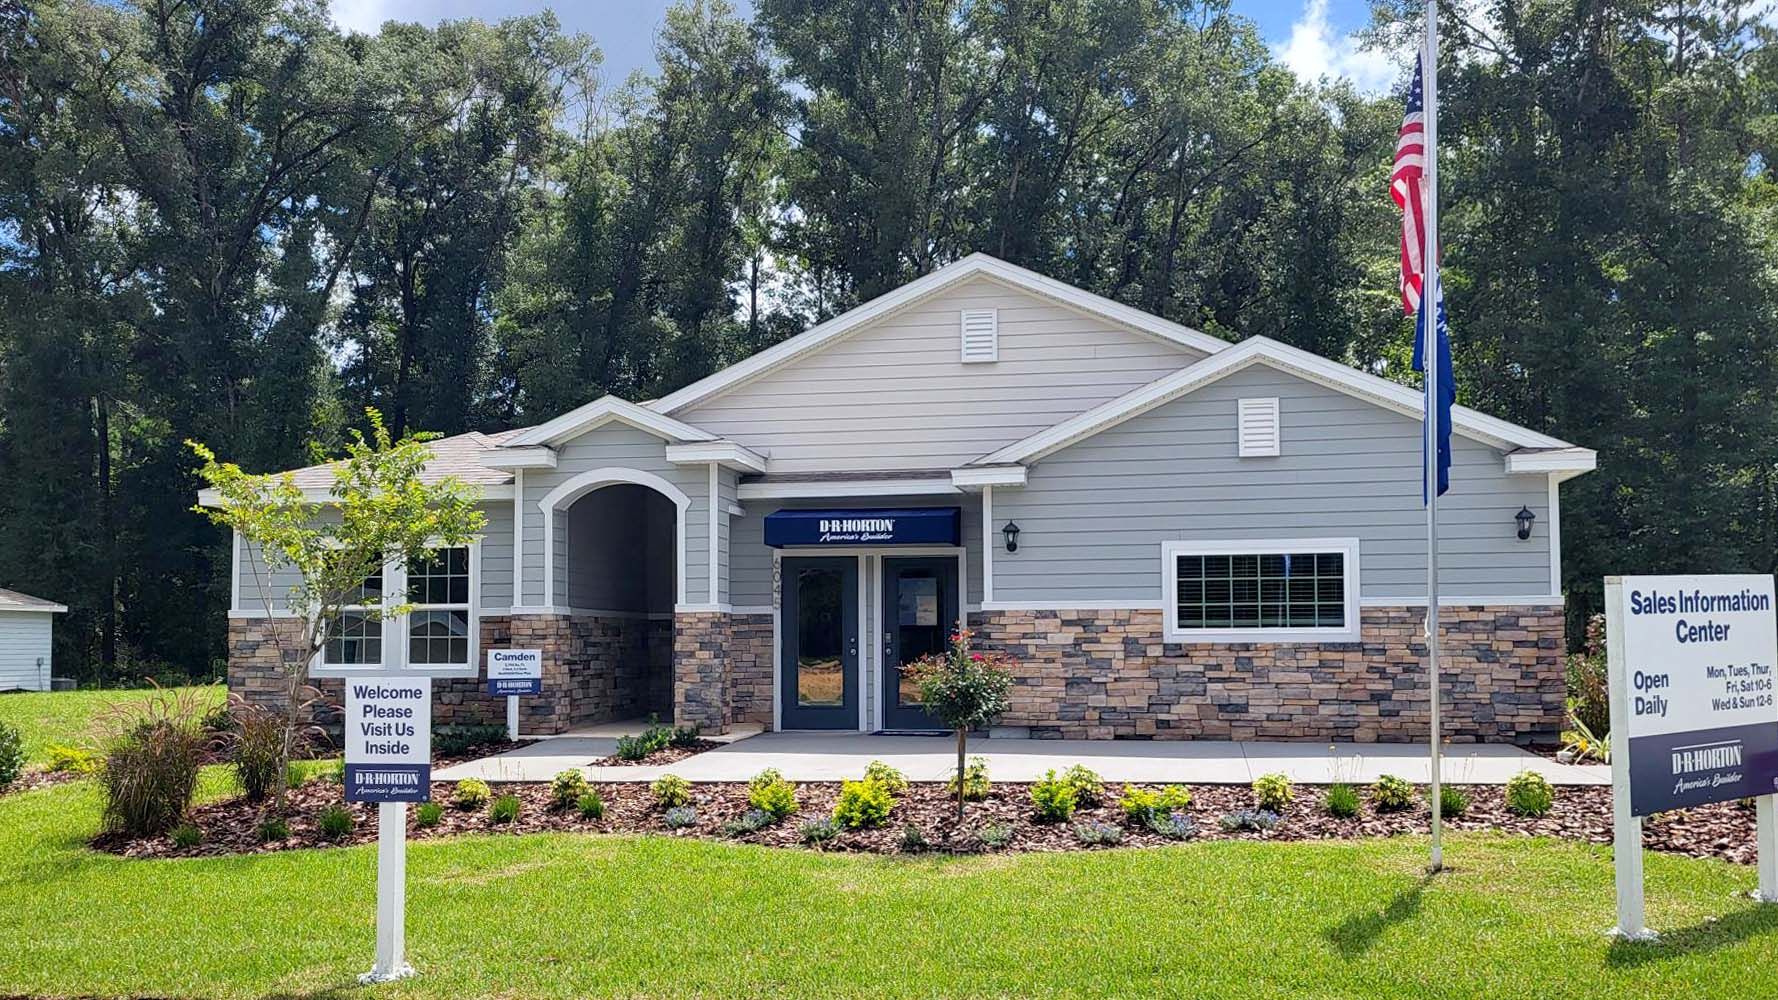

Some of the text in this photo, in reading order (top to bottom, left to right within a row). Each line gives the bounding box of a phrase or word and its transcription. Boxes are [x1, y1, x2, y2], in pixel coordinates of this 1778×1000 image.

[819, 533, 893, 542] America's Builder
[1630, 588, 1769, 615] Sales Information
[1675, 619, 1730, 643] Center
[494, 652, 536, 661] Camden
[1706, 663, 1772, 680] Mon, Tues, Thur,
[1634, 670, 1669, 693] Open
[1726, 678, 1772, 695] Fri, Sat 10-6
[353, 685, 423, 700] Welcome
[363, 704, 413, 718] Please
[1635, 695, 1668, 718] Daily
[1712, 695, 1773, 711] Wed & Sun 12-6
[360, 722, 415, 737] Visit Us
[365, 740, 410, 755] Inside
[355, 786, 389, 795] America's
[1673, 771, 1742, 795] America's Builder
